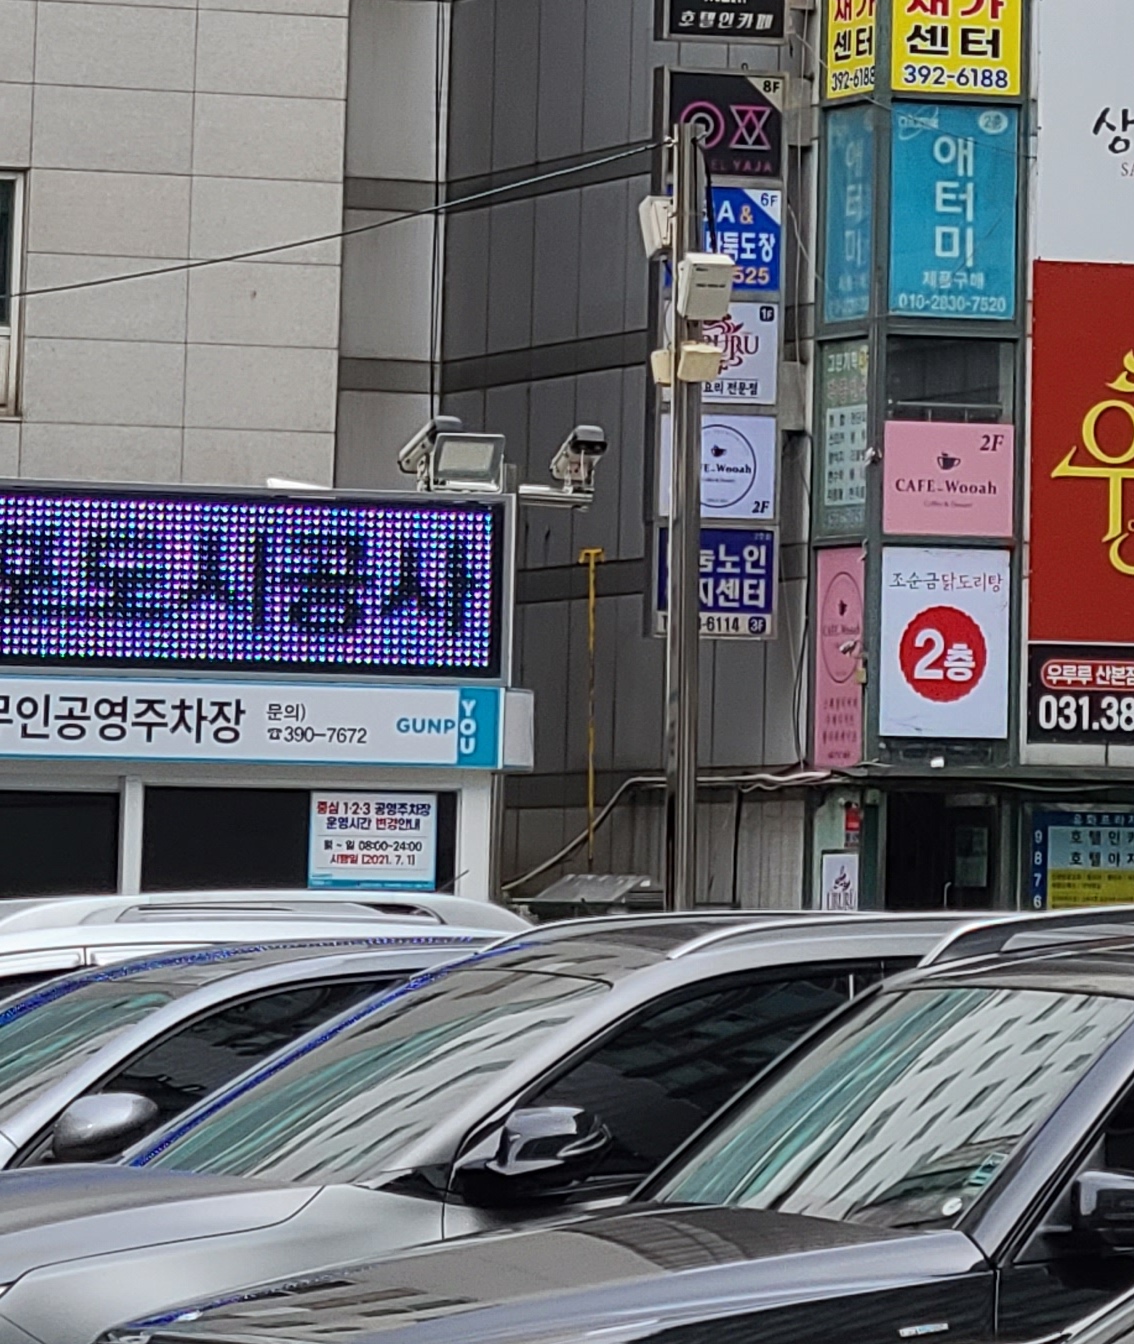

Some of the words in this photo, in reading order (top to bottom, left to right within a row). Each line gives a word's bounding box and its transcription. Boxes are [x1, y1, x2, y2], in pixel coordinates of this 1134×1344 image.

[678, 10, 774, 30] 호텔인카페
[833, 25, 875, 63] 센터
[906, 24, 1002, 60] 센터
[903, 64, 1008, 89] 392-6188
[763, 79, 780, 93] 8F
[761, 192, 778, 207] 6F
[933, 135, 974, 268] 애터미
[979, 433, 1005, 452] 2F
[751, 500, 770, 514] 2F
[889, 571, 1003, 593] 조순금닭도리탕
[914, 627, 975, 682] 2층
[1046, 665, 1093, 684] 우루루
[266, 702, 306, 722] 문의)
[284, 727, 368, 745] 390-7672
[375, 802, 431, 817] 공영주차장
[326, 816, 372, 831] 운영시간
[376, 817, 421, 831] 변경안내
[1034, 829, 1043, 844] 9
[1034, 851, 1043, 866] 8
[1033, 873, 1042, 888] 7
[1033, 895, 1042, 909] 6
